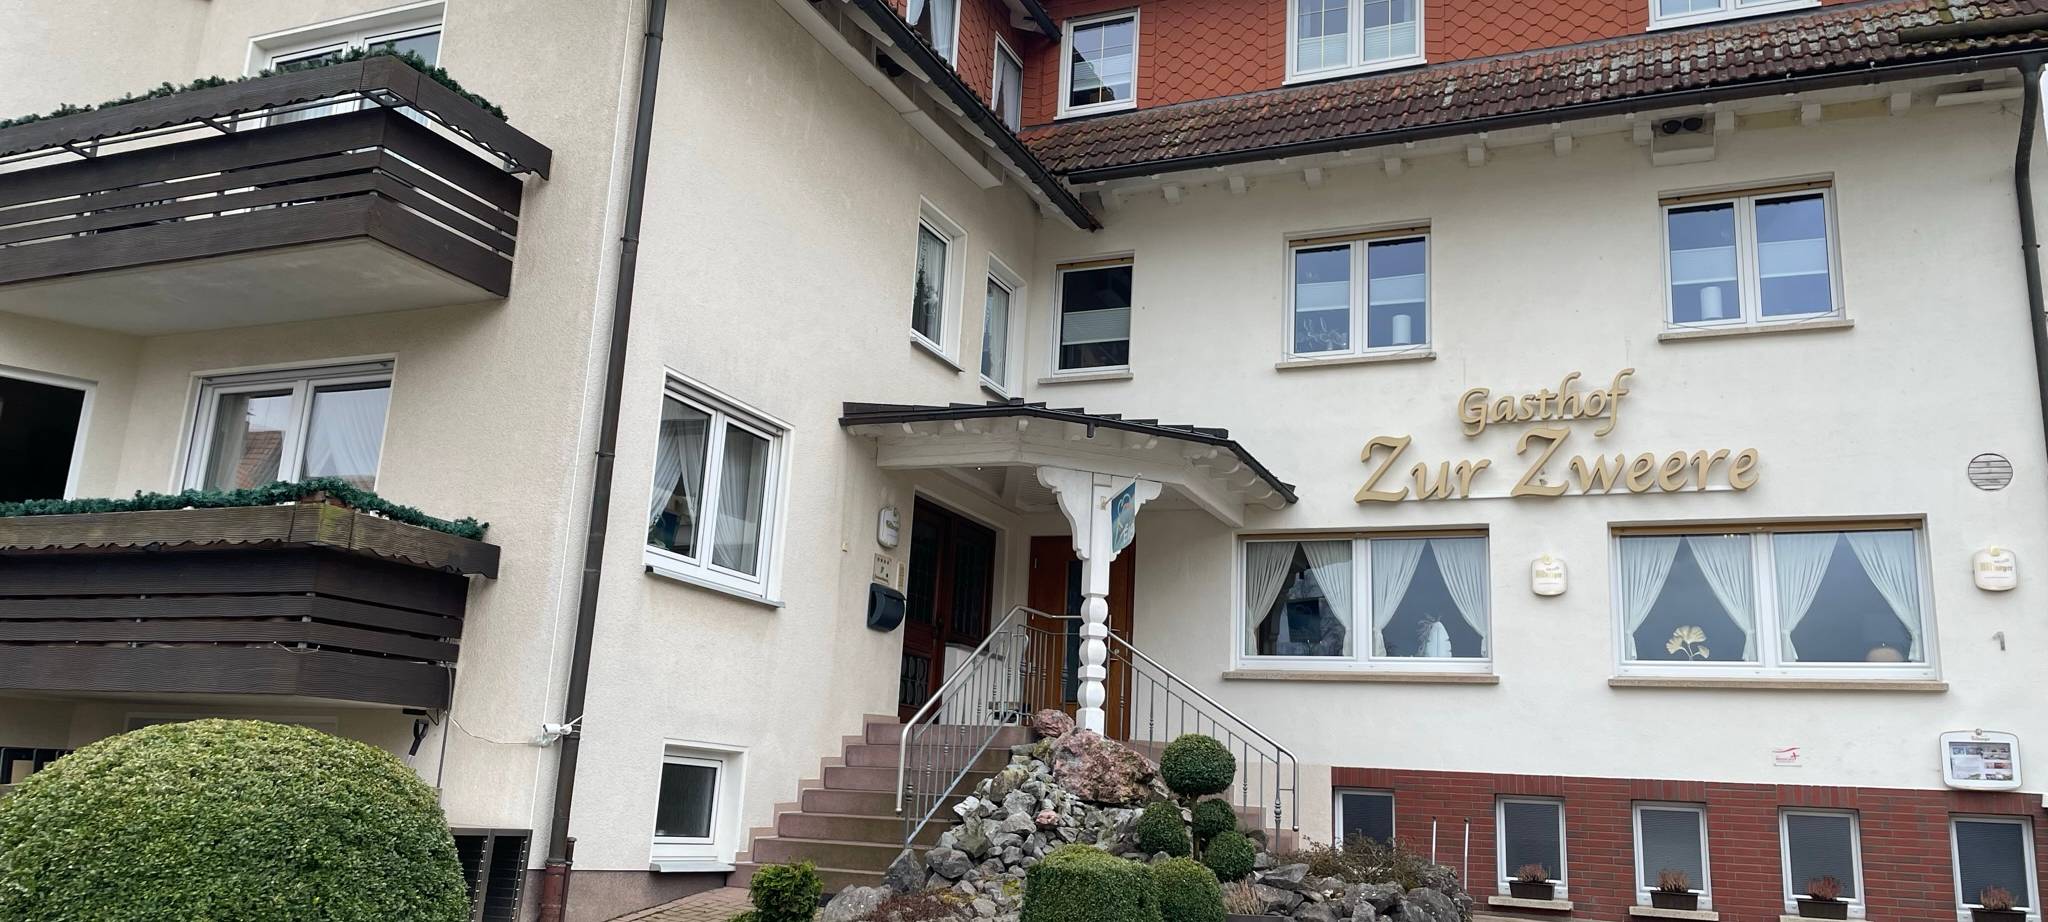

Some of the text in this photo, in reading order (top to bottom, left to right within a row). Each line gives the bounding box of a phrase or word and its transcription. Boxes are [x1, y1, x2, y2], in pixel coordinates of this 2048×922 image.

[1458, 367, 1635, 438] Gasthof
[1354, 426, 1760, 504] Zur Zweere
